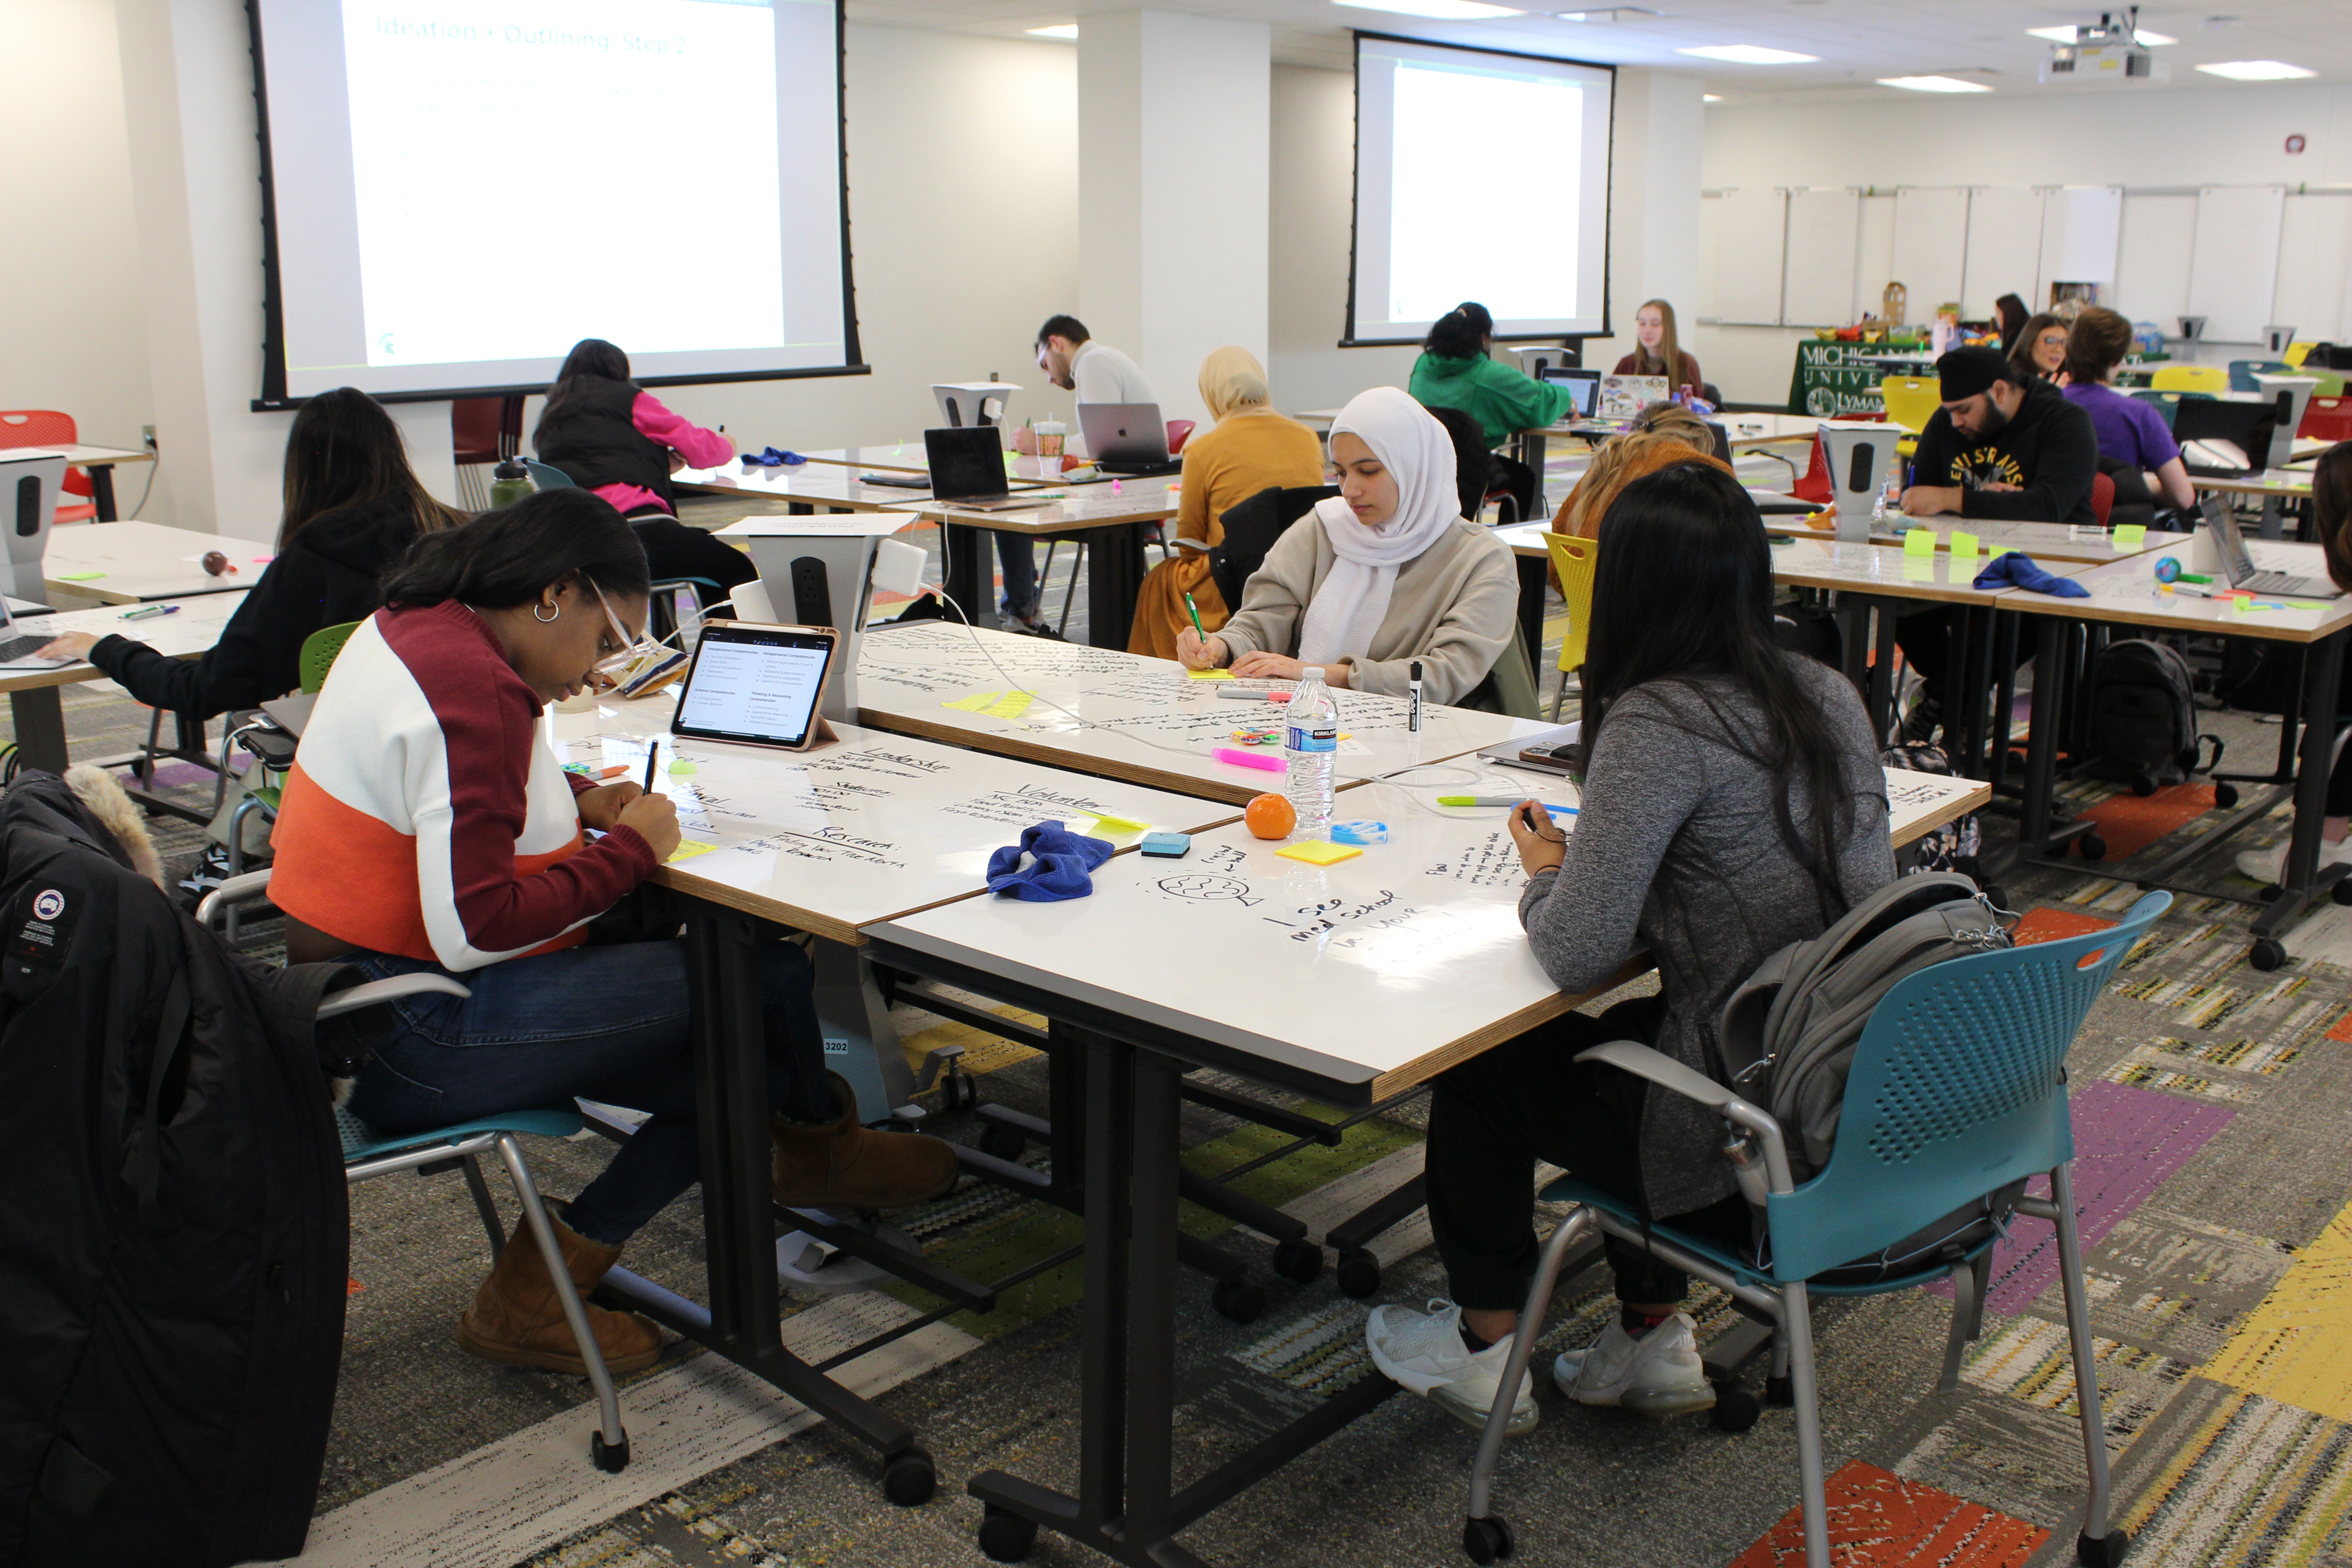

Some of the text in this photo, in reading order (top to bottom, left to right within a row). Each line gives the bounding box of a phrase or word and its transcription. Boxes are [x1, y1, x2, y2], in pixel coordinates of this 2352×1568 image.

[376, 16, 476, 40] Ideation
[505, 24, 615, 53] Outlining:
[622, 33, 669, 56] Step
[676, 37, 686, 54] 2
[1838, 392, 1883, 409] LYMAN
[1226, 850, 1247, 863] ball
[1425, 863, 1448, 875] Flow
[1291, 889, 1404, 942] med school
[1297, 898, 1347, 916] see
[825, 1042, 848, 1051] 3202
